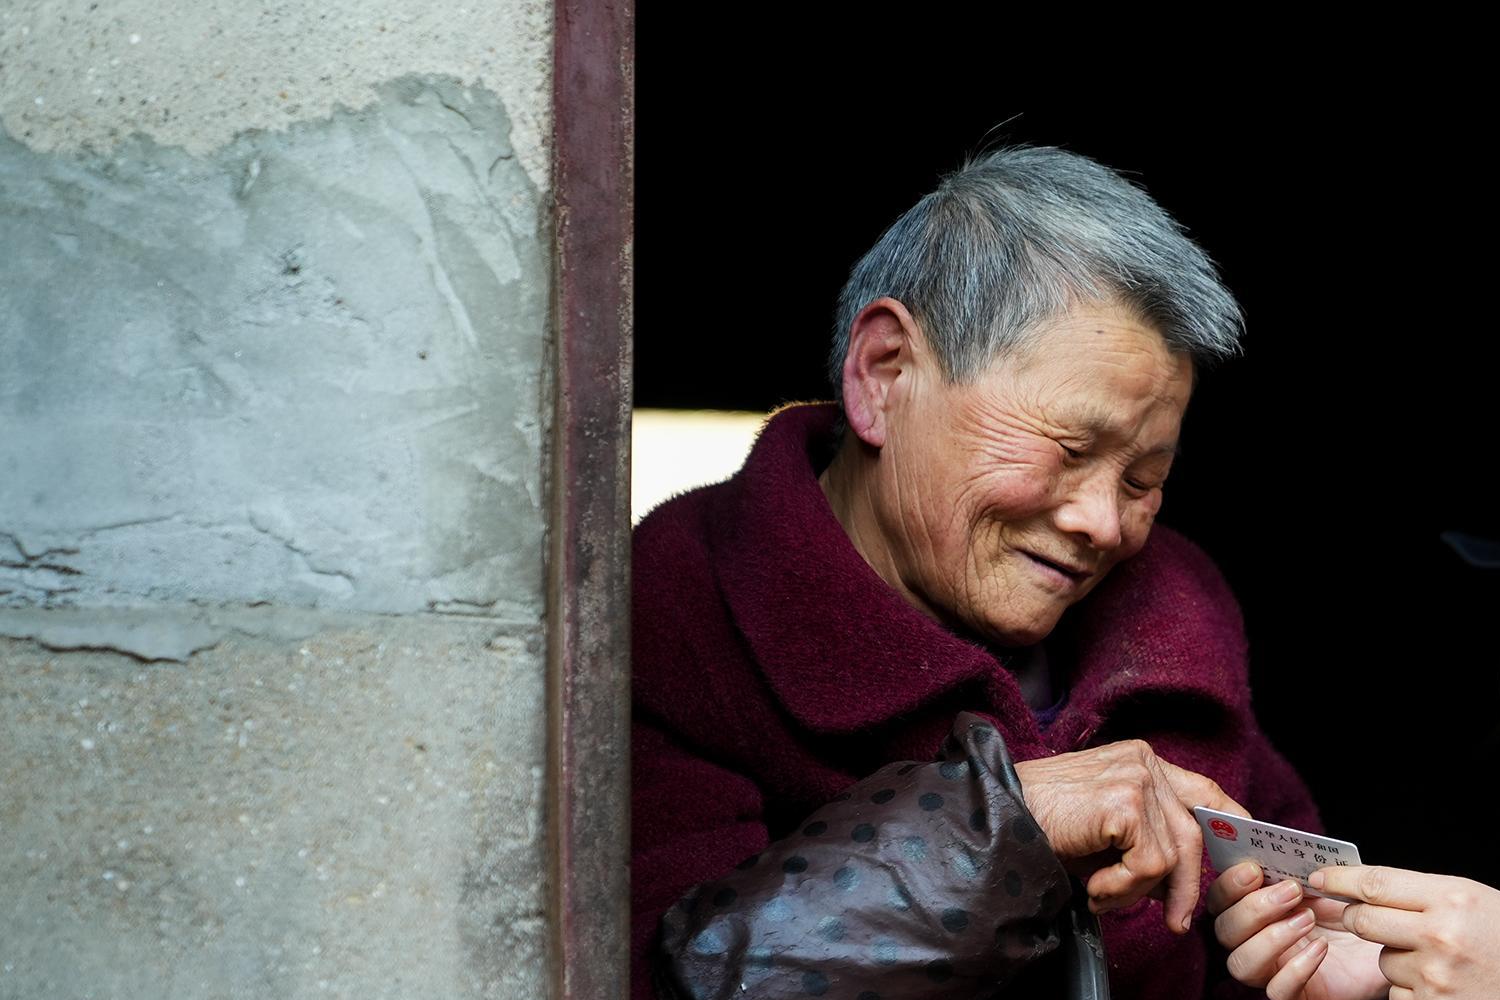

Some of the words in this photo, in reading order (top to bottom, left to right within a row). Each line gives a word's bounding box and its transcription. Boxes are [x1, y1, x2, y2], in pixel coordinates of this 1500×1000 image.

[1251, 828, 1339, 855] 中华人民共和国
